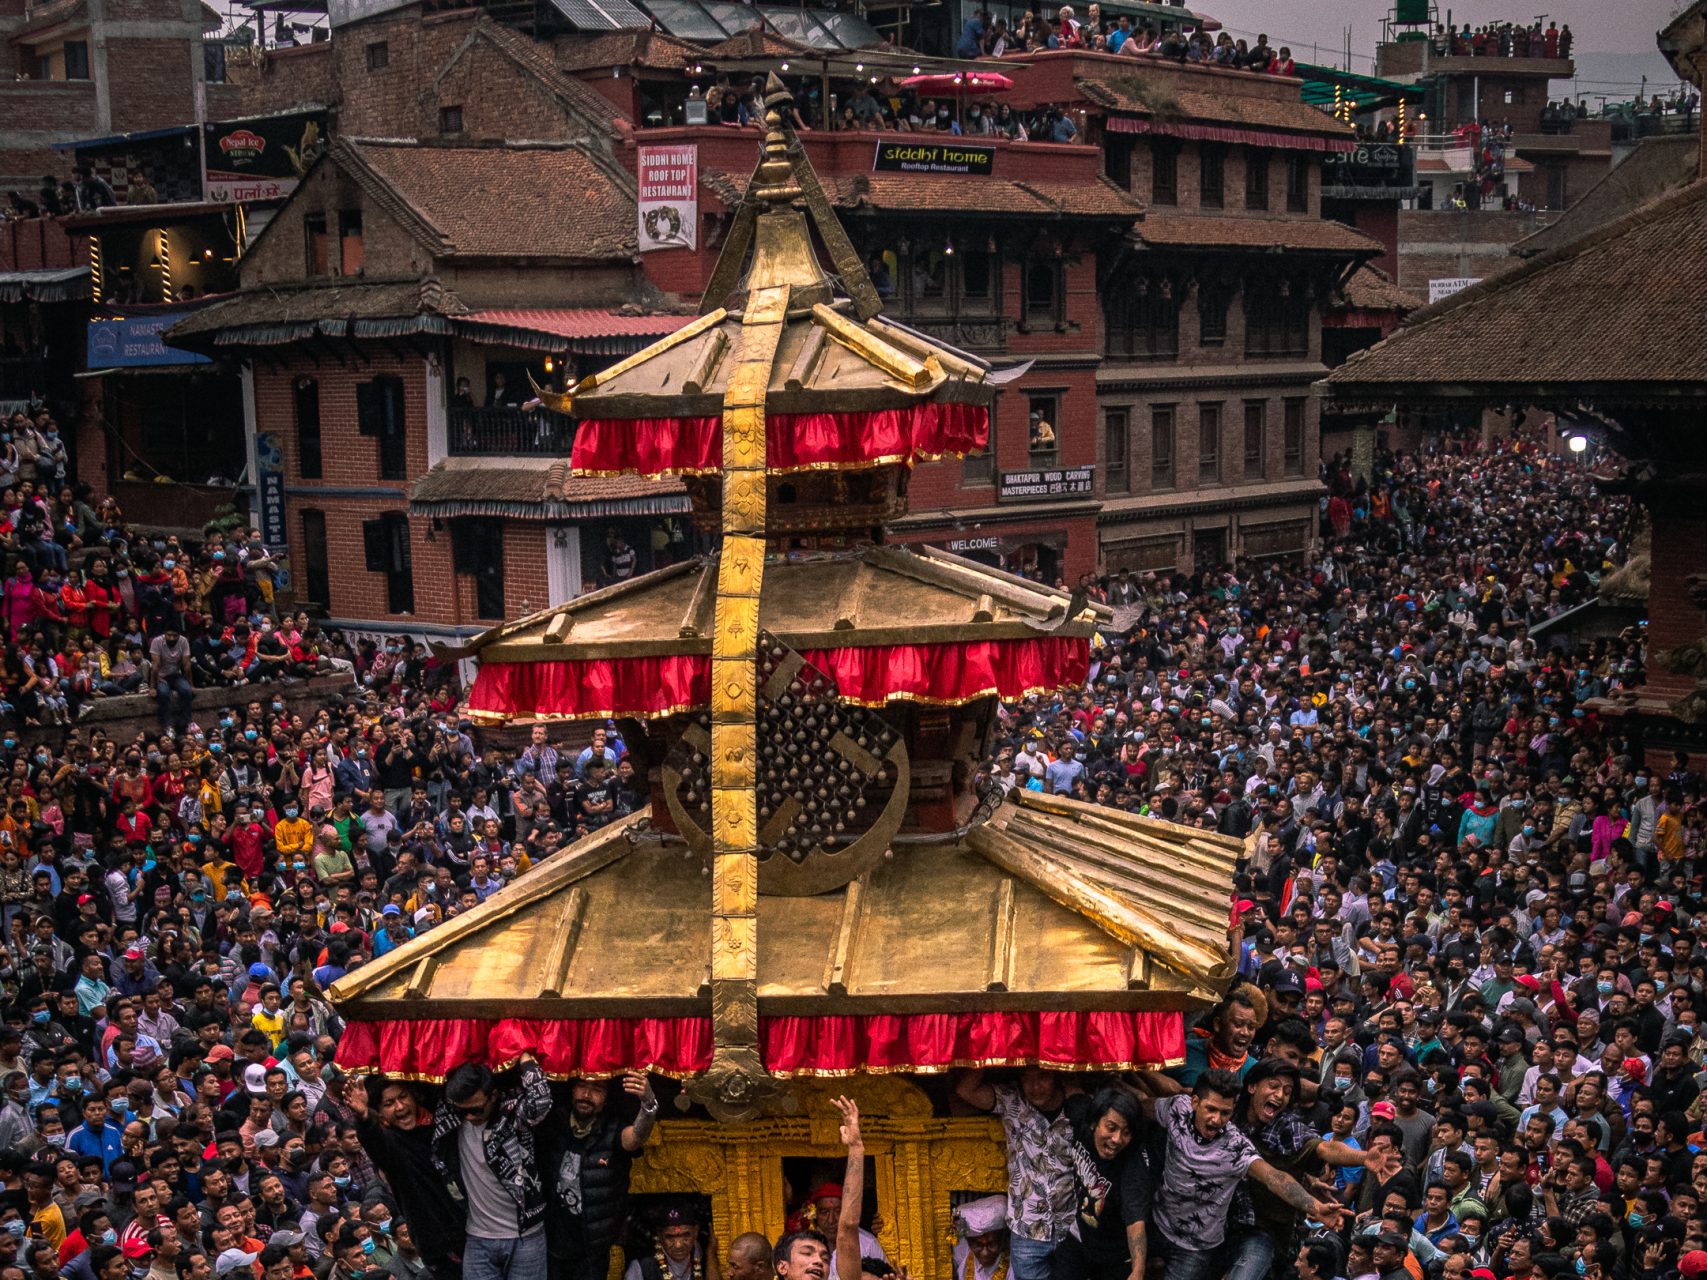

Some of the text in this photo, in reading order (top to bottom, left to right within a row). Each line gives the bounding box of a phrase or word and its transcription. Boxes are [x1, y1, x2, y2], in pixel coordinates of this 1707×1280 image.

[248, 138, 259, 146] Ice
[641, 153, 694, 167] SIDDHI HOME
[885, 147, 988, 164] siddhi home
[901, 162, 969, 172] Rooftop Restaurant
[648, 169, 686, 182] ROOF TOP
[642, 185, 693, 197] RESTAURANT
[1005, 470, 1090, 484] BHAKTAPUR WOOD CARVING
[1001, 484, 1048, 496] MASTERPIECES
[267, 476, 281, 543] NAMASTE
[951, 537, 997, 550] WELCOME
